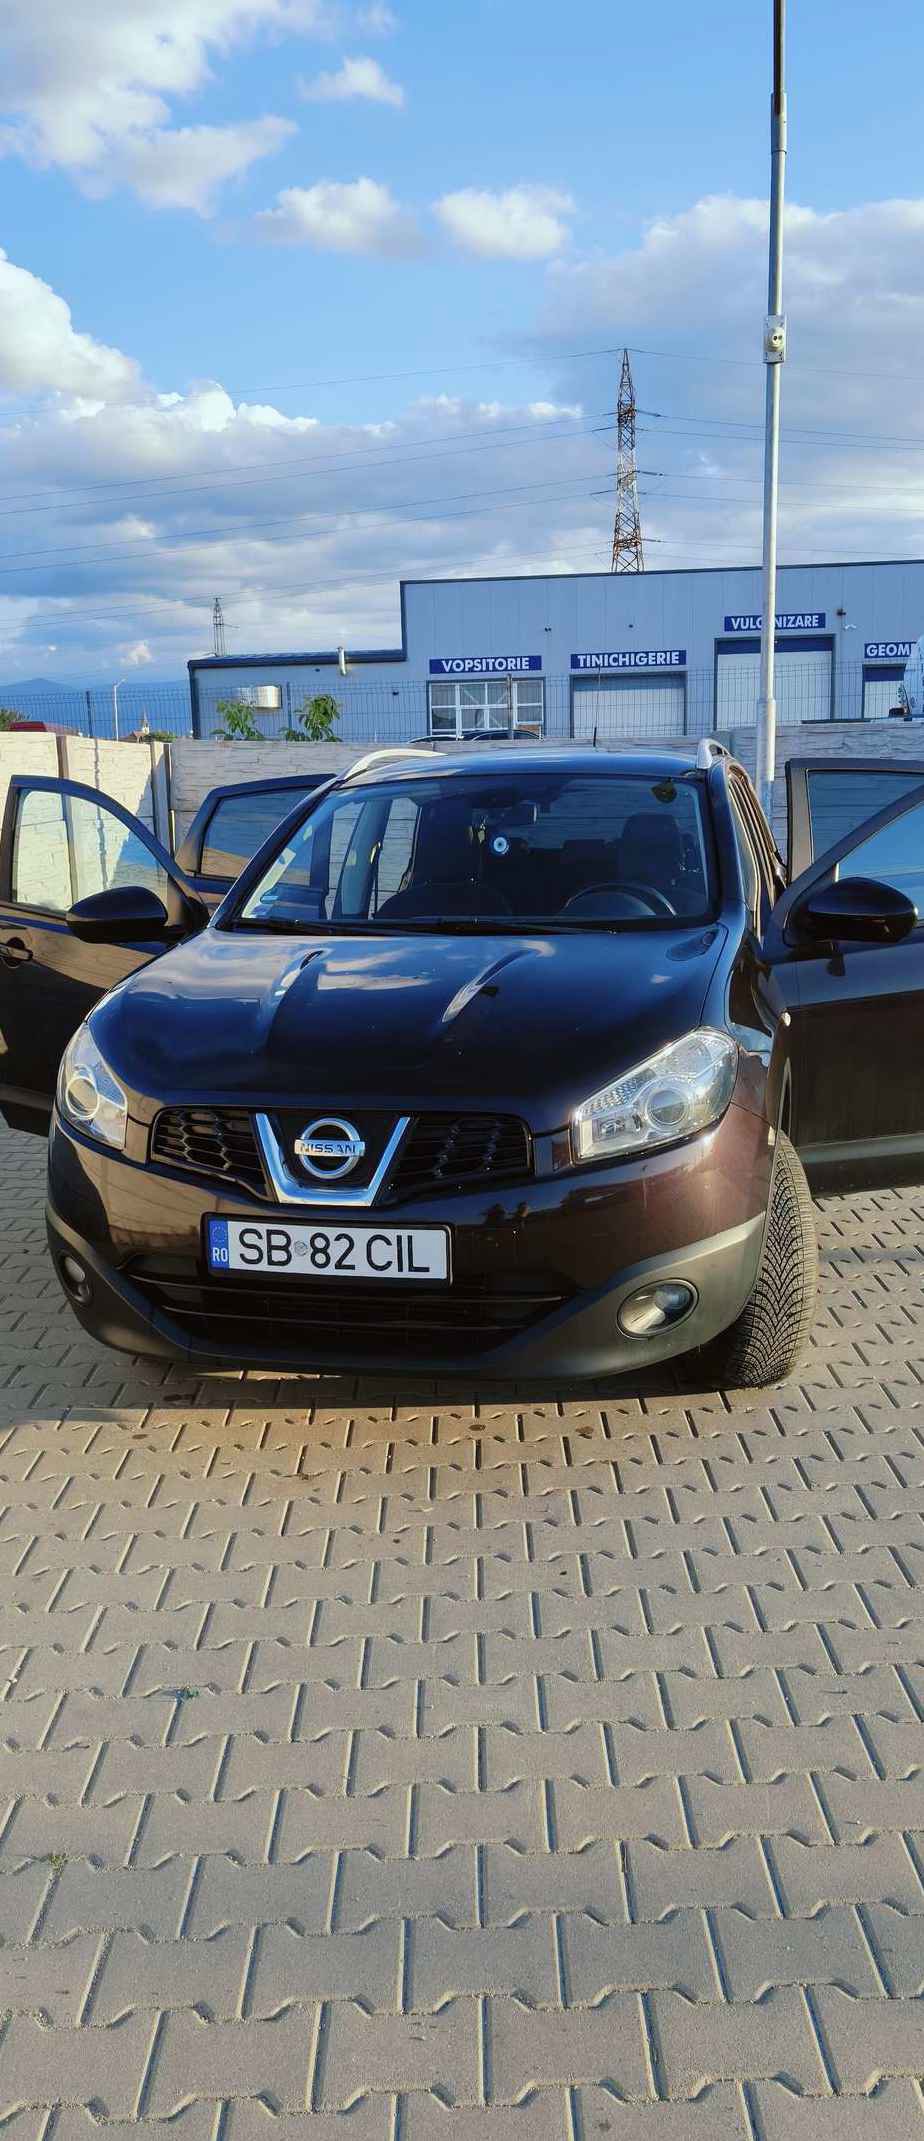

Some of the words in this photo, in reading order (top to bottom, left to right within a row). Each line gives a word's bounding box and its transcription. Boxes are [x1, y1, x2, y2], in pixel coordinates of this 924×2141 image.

[731, 615, 819, 630] VULCNIZARE
[866, 643, 914, 656] GEOM
[442, 657, 530, 672] VOPSITORIE
[577, 651, 680, 668] TINICHIGERIE
[300, 1143, 356, 1153] NISSAN
[212, 1247, 228, 1262] RO
[238, 1228, 293, 1266] SB
[309, 1232, 356, 1270] 82
[366, 1234, 430, 1273] CIL
